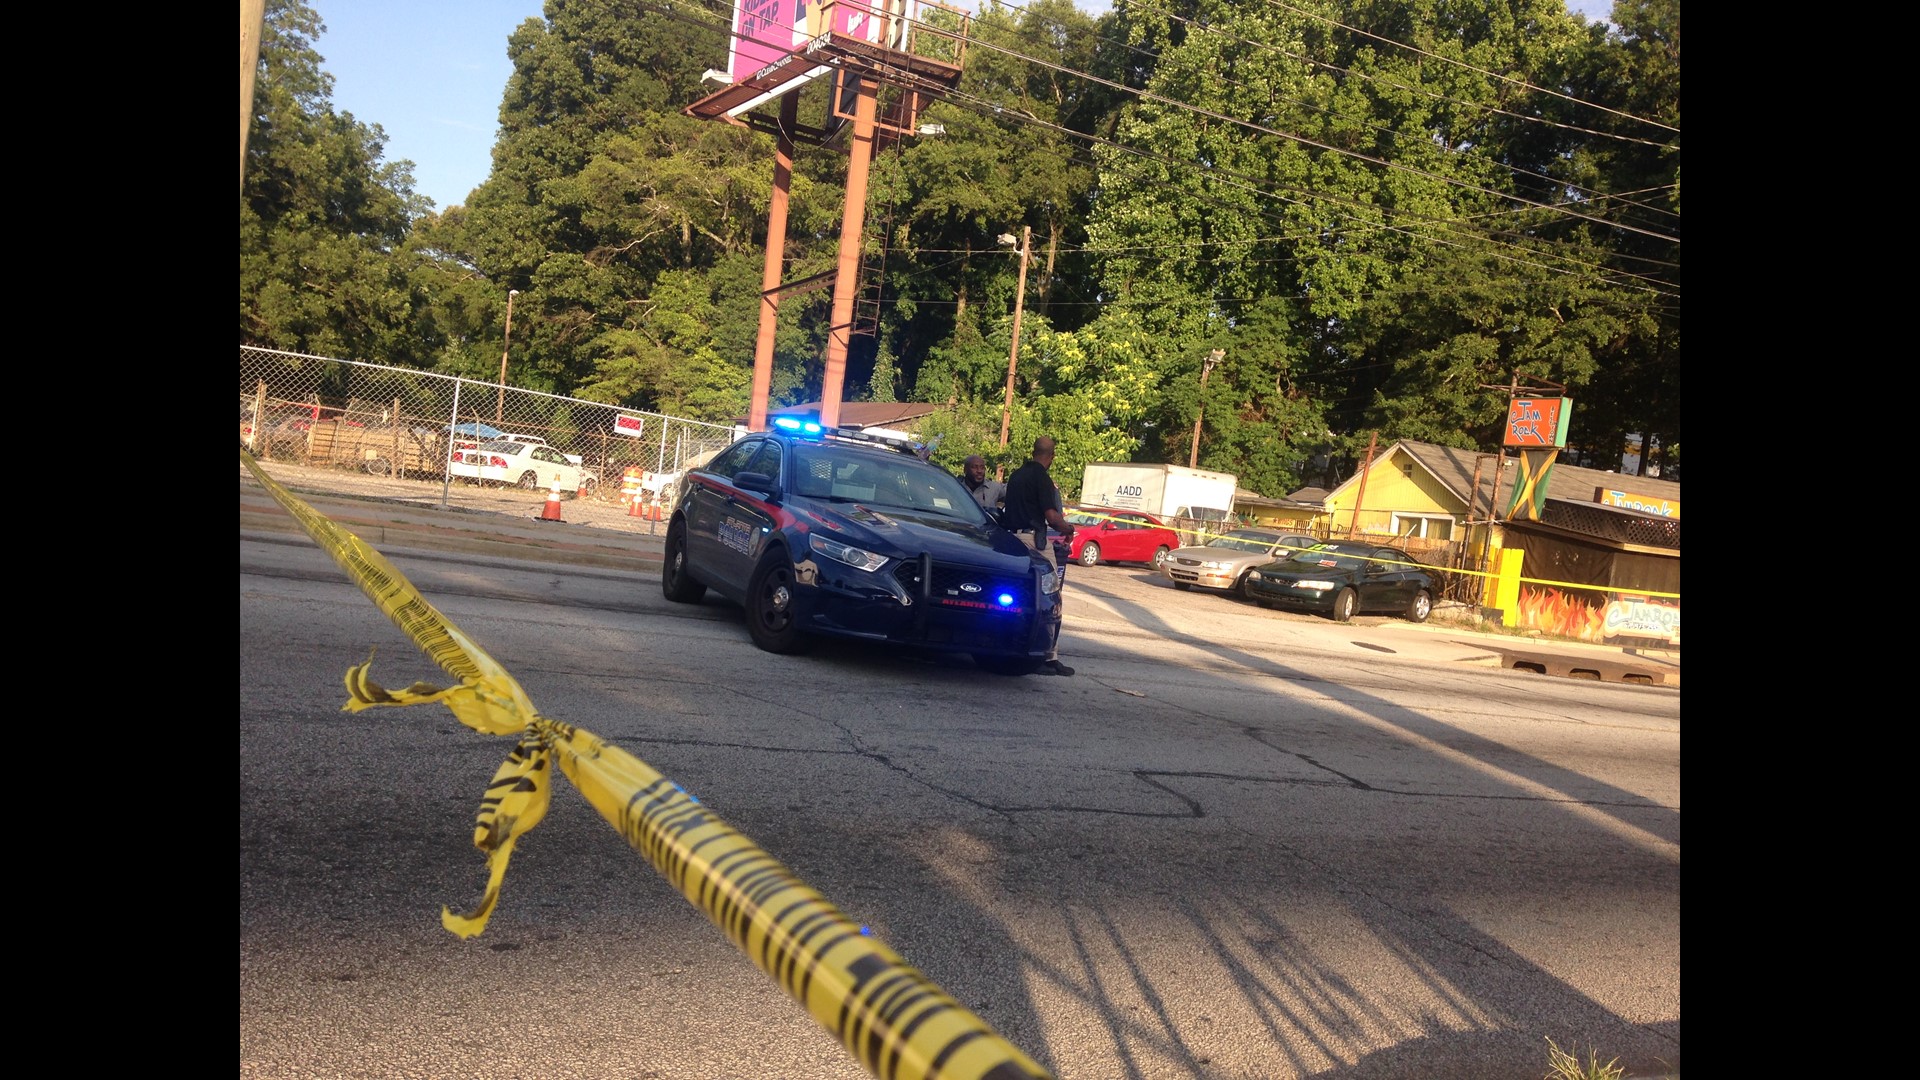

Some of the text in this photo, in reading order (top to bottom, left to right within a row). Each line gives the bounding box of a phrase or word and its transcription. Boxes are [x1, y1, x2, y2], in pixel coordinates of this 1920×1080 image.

[759, 1, 779, 32] TAP.
[1510, 401, 1541, 424] JAM
[1512, 421, 1545, 444] ROCK
[1116, 485, 1142, 497] AADD
[717, 521, 750, 555] POLICE
[942, 599, 986, 610] ATLANTA
